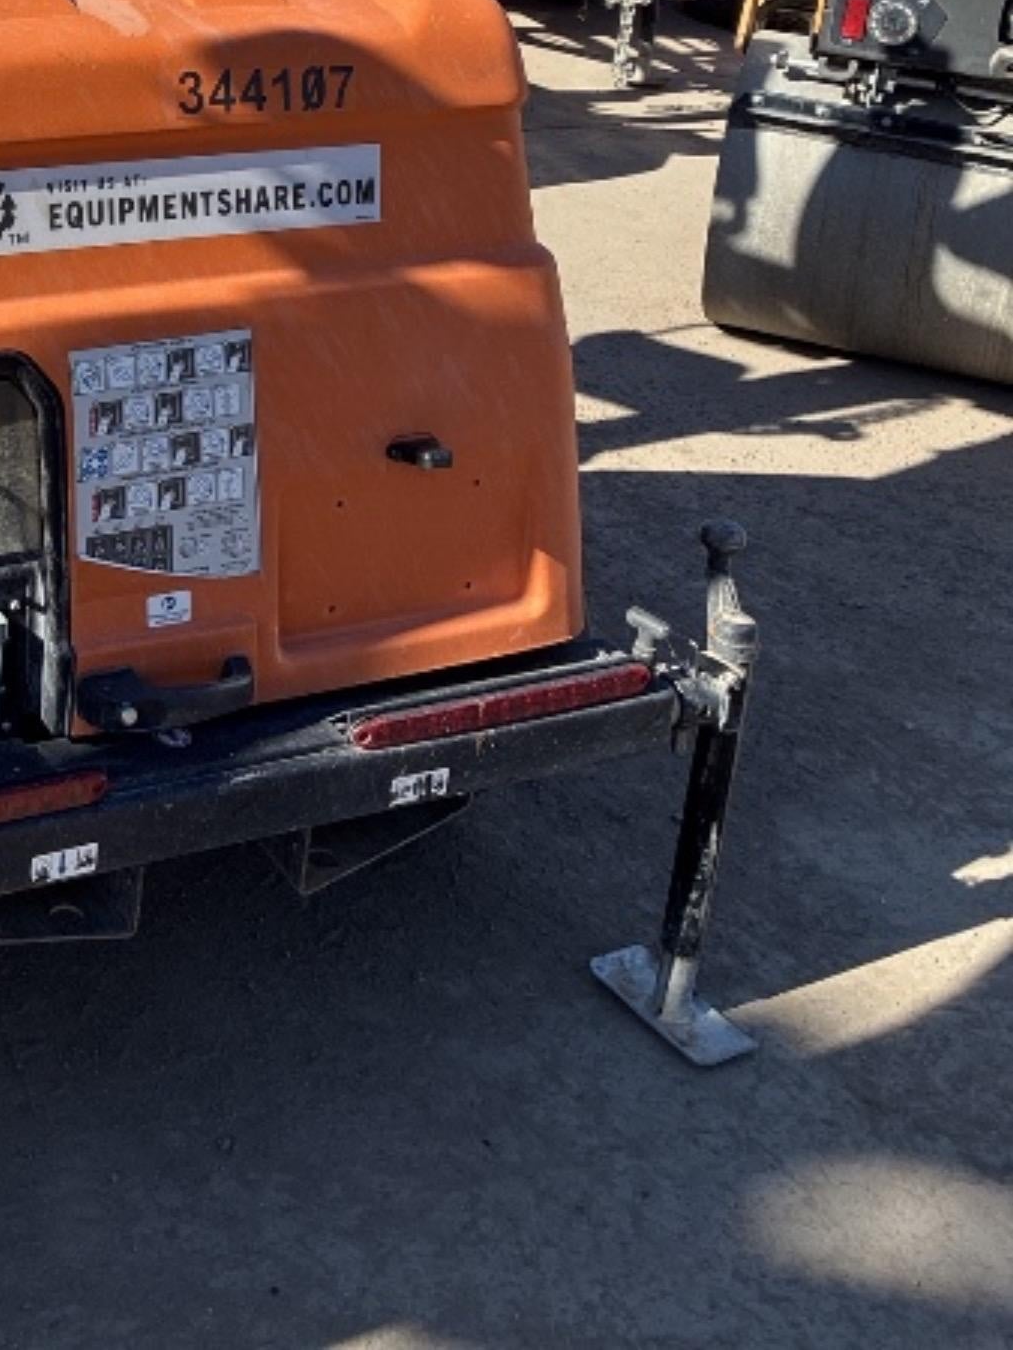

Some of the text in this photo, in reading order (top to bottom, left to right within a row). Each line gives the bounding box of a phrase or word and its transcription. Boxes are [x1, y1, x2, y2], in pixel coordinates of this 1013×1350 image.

[178, 65, 355, 115] 344107
[46, 179, 87, 194] VISIT
[97, 176, 114, 190] US
[48, 177, 376, 232] EQUIPMENTSHARE.COM
